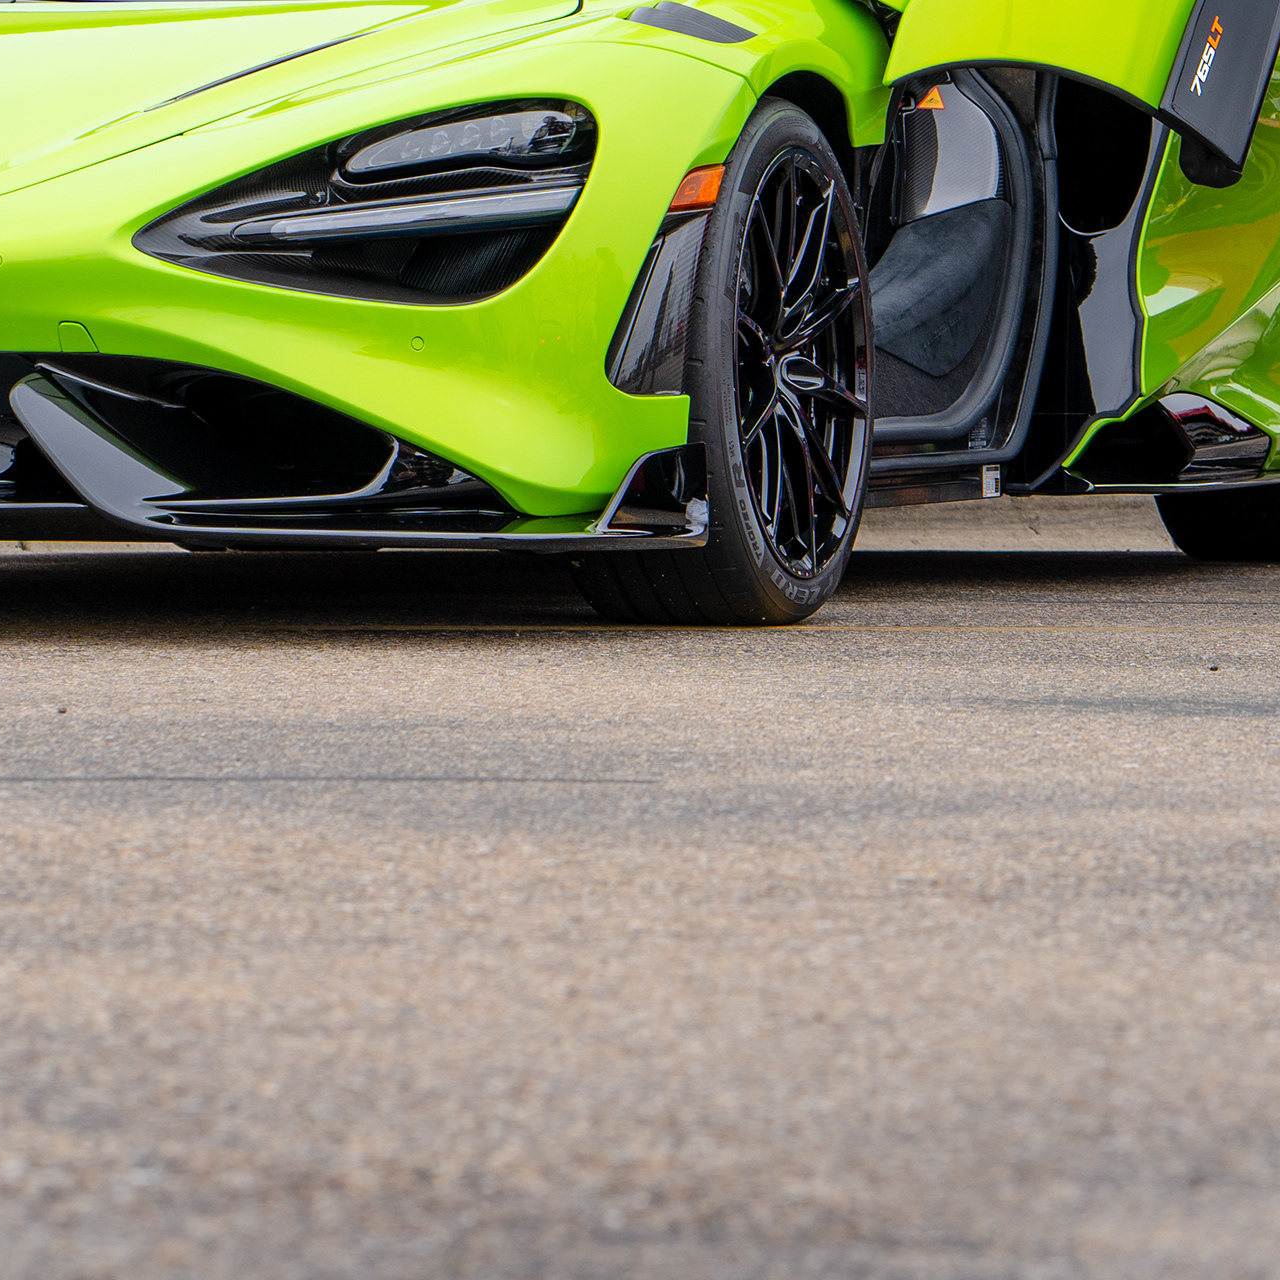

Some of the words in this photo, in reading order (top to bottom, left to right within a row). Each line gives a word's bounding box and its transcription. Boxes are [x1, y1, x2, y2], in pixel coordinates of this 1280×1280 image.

[1190, 15, 1223, 97] 765LT
[738, 499, 763, 560] TROFEO
[770, 569, 821, 606] ZERO
